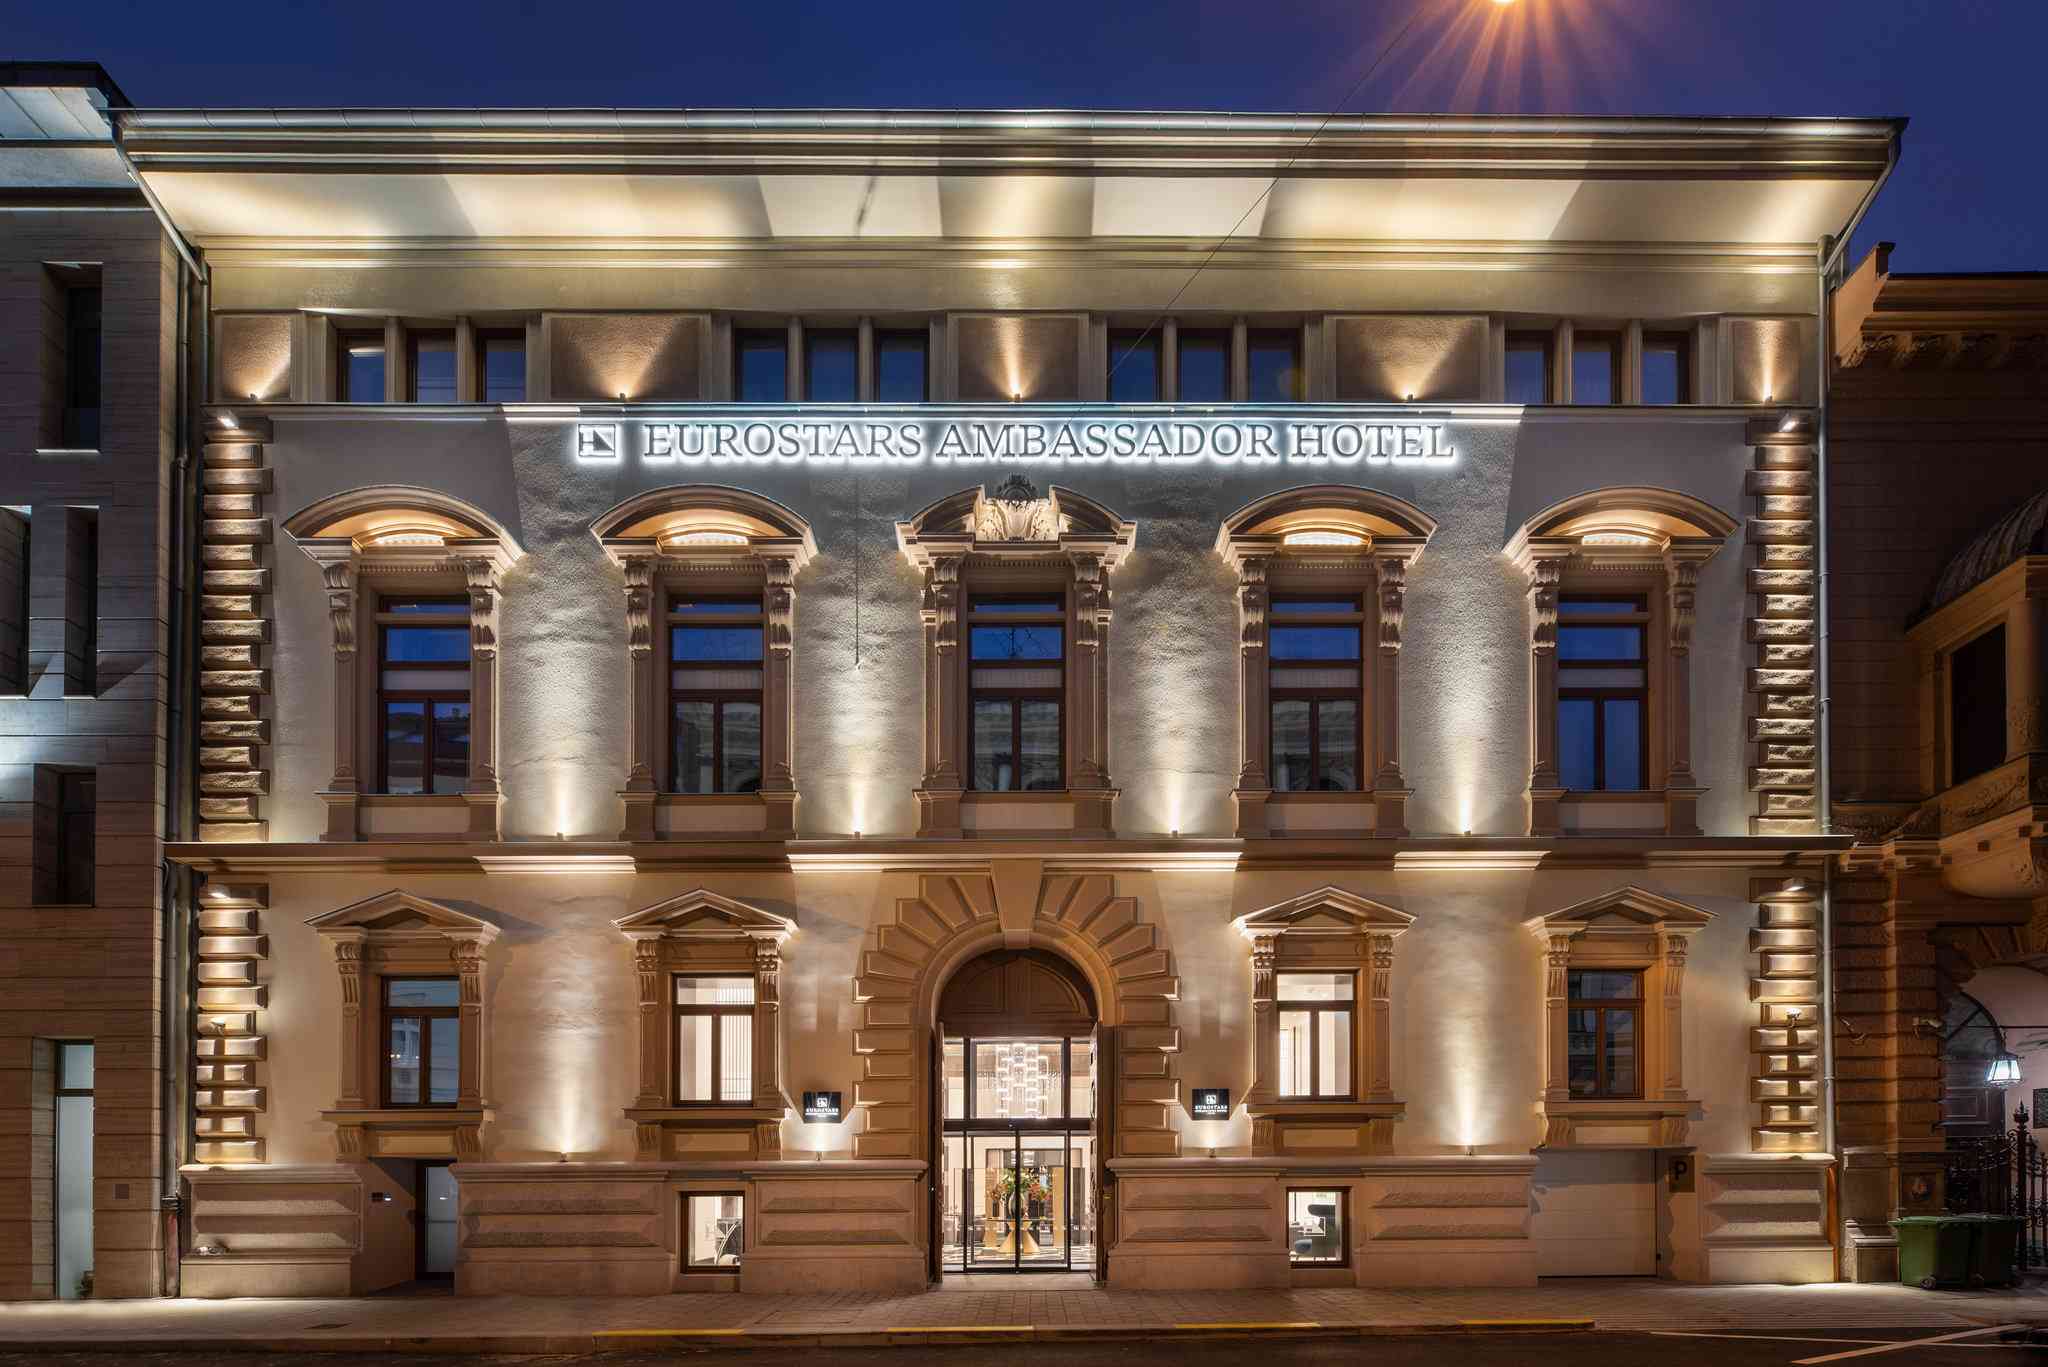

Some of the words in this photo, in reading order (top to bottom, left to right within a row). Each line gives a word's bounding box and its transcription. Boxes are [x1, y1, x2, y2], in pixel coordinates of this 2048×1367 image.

[643, 423, 921, 458] EUROSTARS
[935, 423, 1278, 458] AMBASSADOR
[1290, 423, 1455, 458] HOTEL
